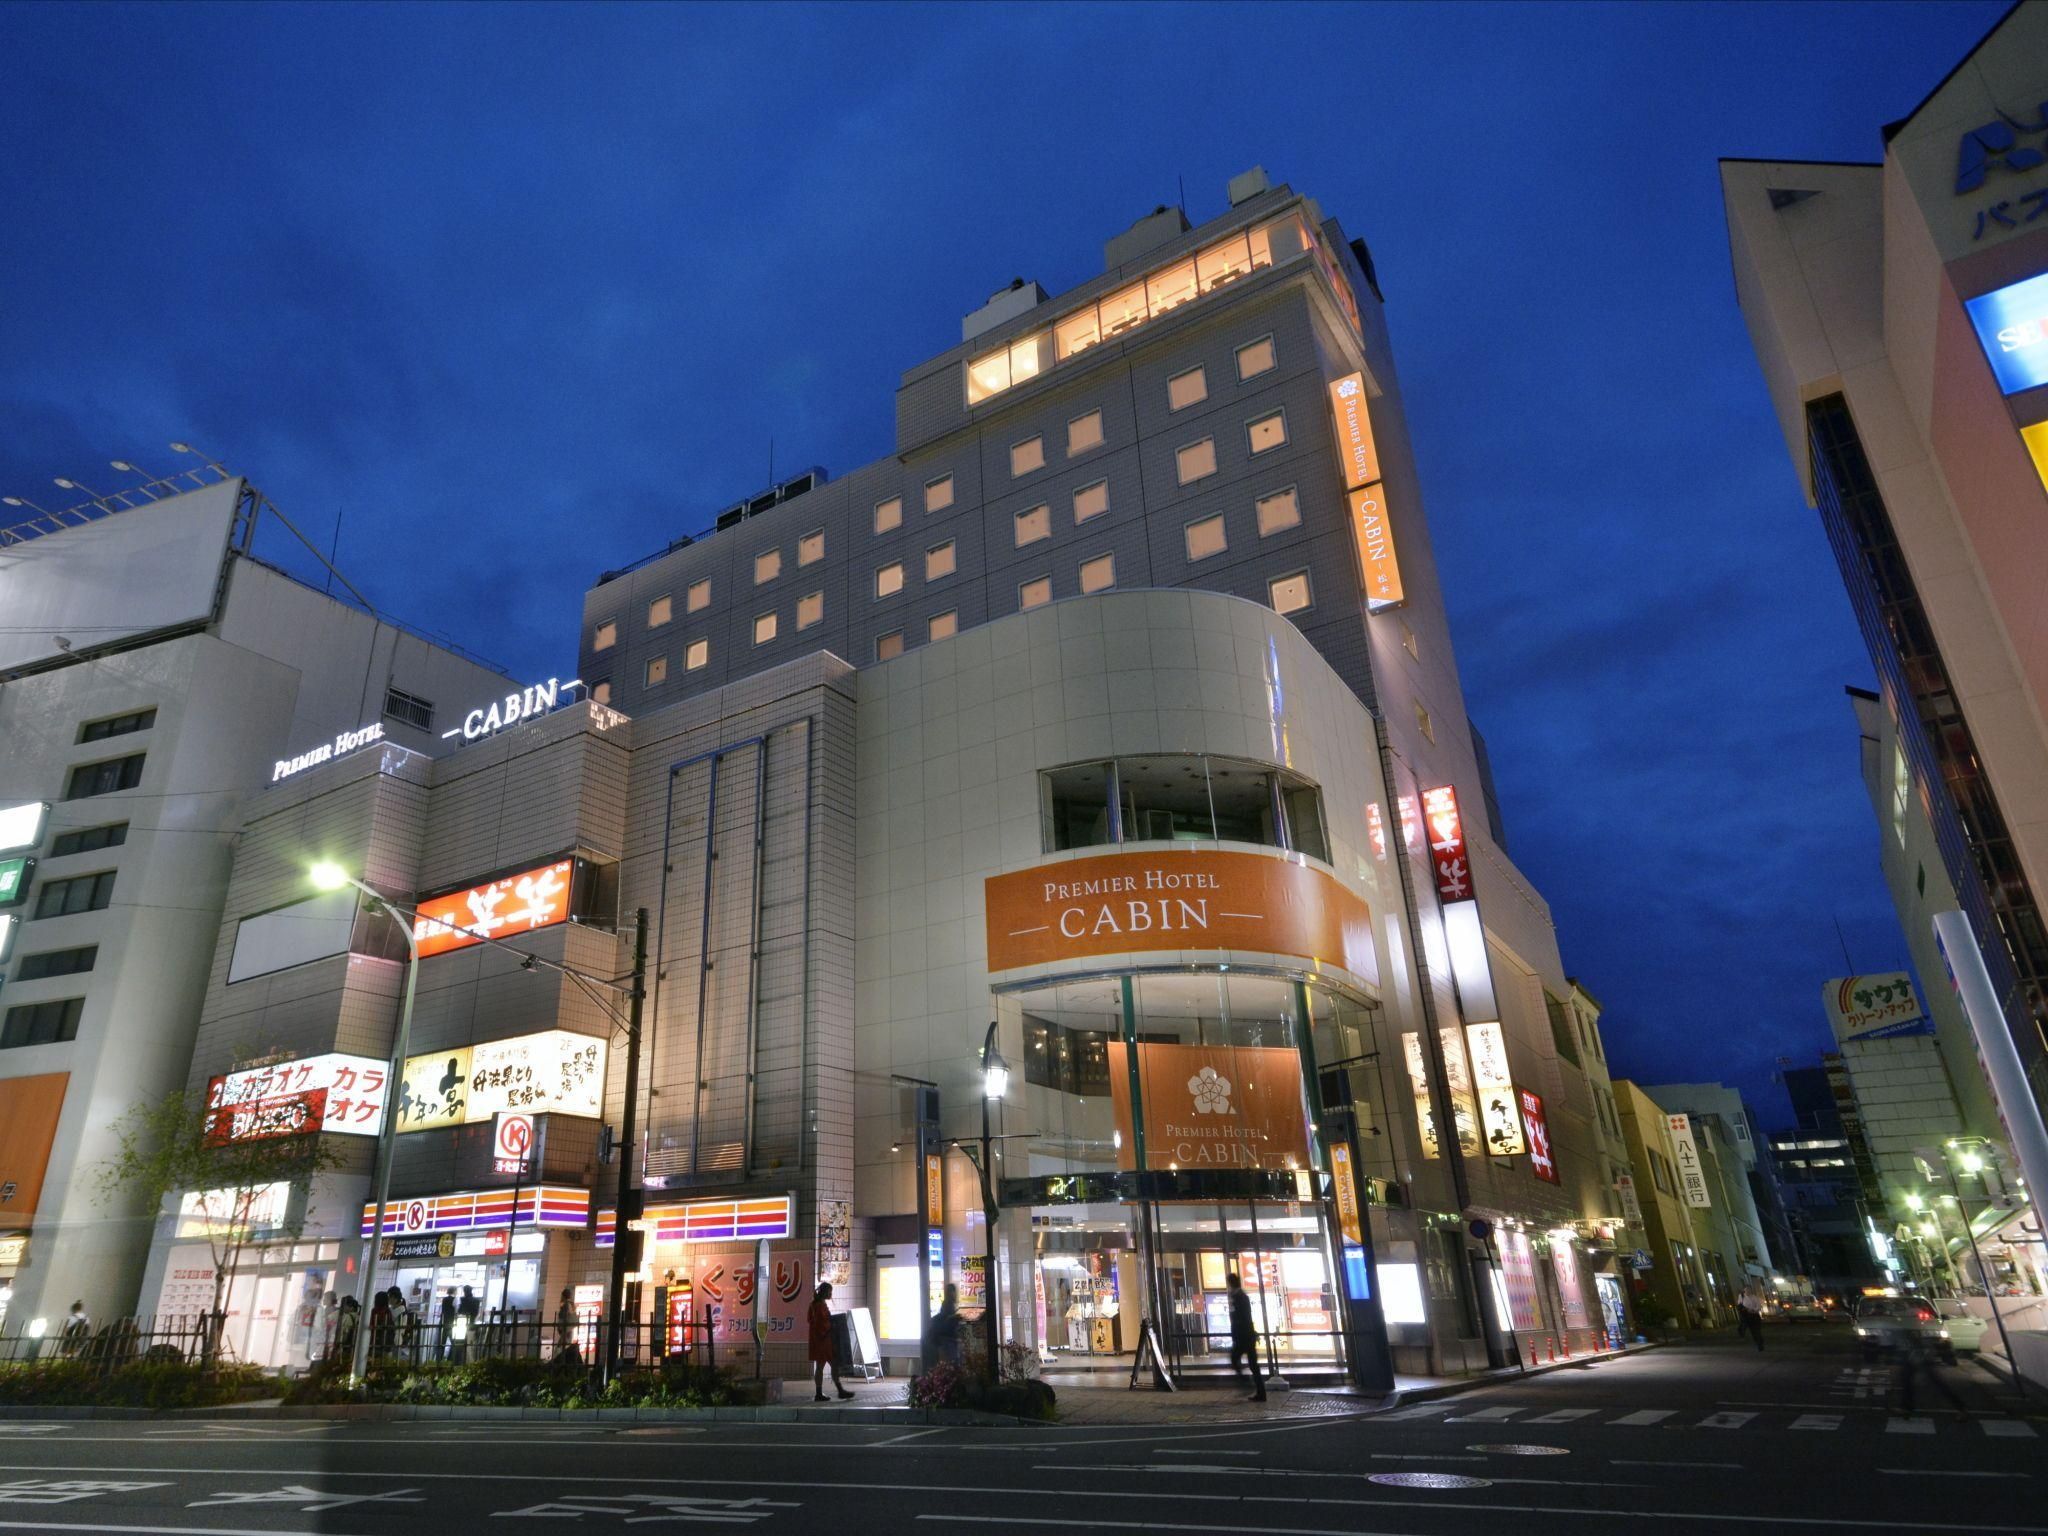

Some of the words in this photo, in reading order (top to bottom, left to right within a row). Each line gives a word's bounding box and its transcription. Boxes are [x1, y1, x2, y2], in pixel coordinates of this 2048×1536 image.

[1345, 399, 1360, 443] PREMIER
[1353, 443, 1368, 482] HOTEL
[1361, 500, 1387, 560] CABIN
[463, 677, 560, 739] CABIN
[272, 745, 332, 781] PREMIER
[334, 722, 384, 755] HOTEL
[1044, 875, 1136, 902] PREMIER
[1144, 869, 1220, 891] HOTEL
[1059, 898, 1209, 939] CABIN
[1854, 979, 1911, 1009] サウナ
[242, 1063, 314, 1098] カラオケ
[1166, 1124, 1220, 1138] PREMIER
[1223, 1125, 1264, 1138] HOTEL
[1176, 1143, 1259, 1164] CABIN
[1680, 1140, 1704, 1202] 八十二銀行
[701, 1259, 801, 1305] くすり
[728, 1317, 794, 1332] アメリラッグ
